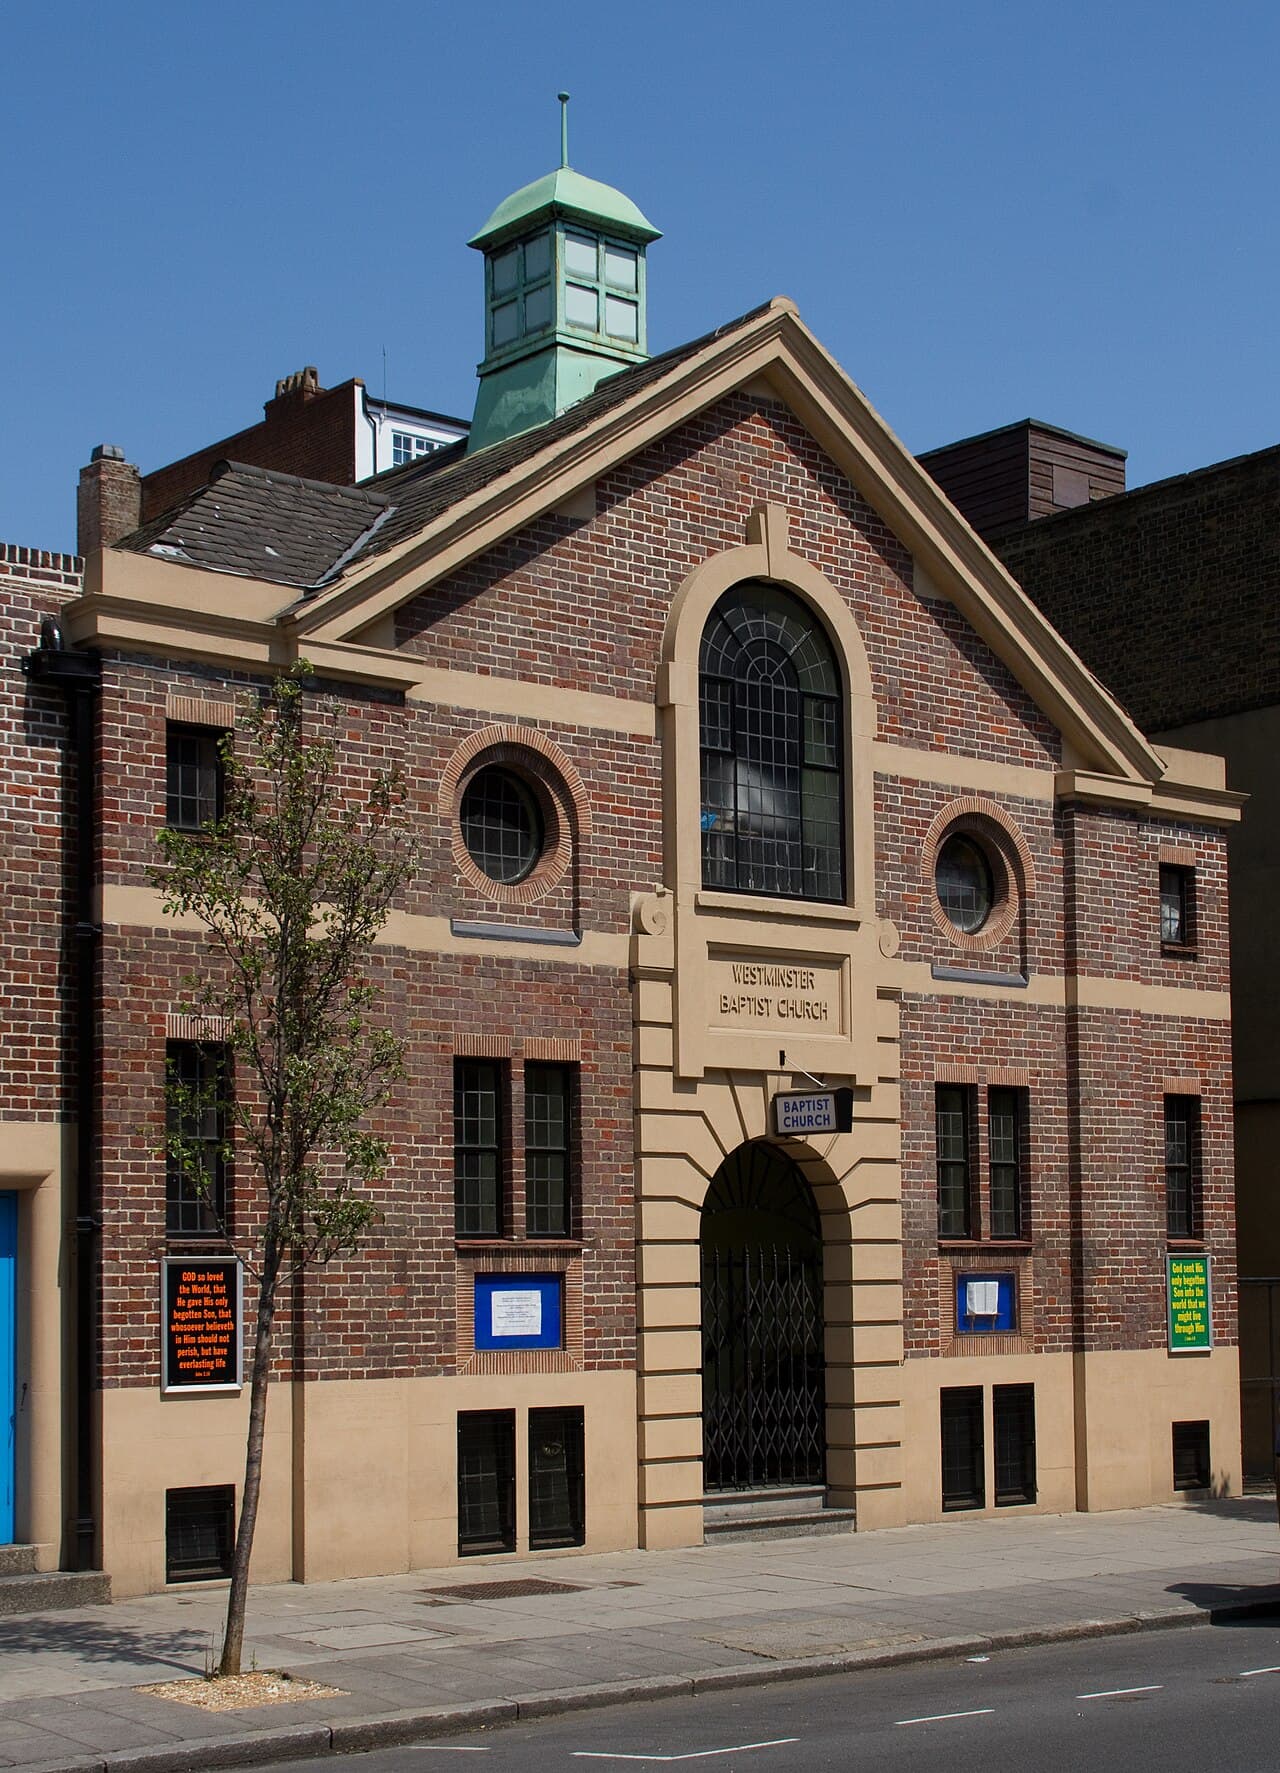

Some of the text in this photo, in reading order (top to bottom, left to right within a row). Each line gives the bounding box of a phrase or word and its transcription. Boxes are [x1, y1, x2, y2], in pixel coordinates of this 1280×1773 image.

[732, 964, 815, 990] WESTMINSTER
[719, 994, 828, 1021] BAPTIST CHURCH
[783, 1098, 830, 1113] BAPTIST
[783, 1114, 831, 1128] CHURCH
[1172, 1263, 1203, 1273] God sent His
[182, 1272, 224, 1282] GOD so loved
[1171, 1274, 1206, 1287] only begotten
[179, 1284, 226, 1297] the World, that
[1173, 1287, 1183, 1297] Son
[1195, 1287, 1204, 1297] the
[176, 1296, 229, 1309] He gave His only
[1172, 1299, 1205, 1309] world that we
[173, 1309, 232, 1321] begotten Son, that
[1177, 1311, 1201, 1323] might live
[171, 1321, 234, 1331] whosoever believeth
[1175, 1322, 1205, 1335] through Him
[175, 1333, 230, 1344] in Him should not
[177, 1345, 228, 1358] perish, but have
[179, 1358, 226, 1370] everlasting life
